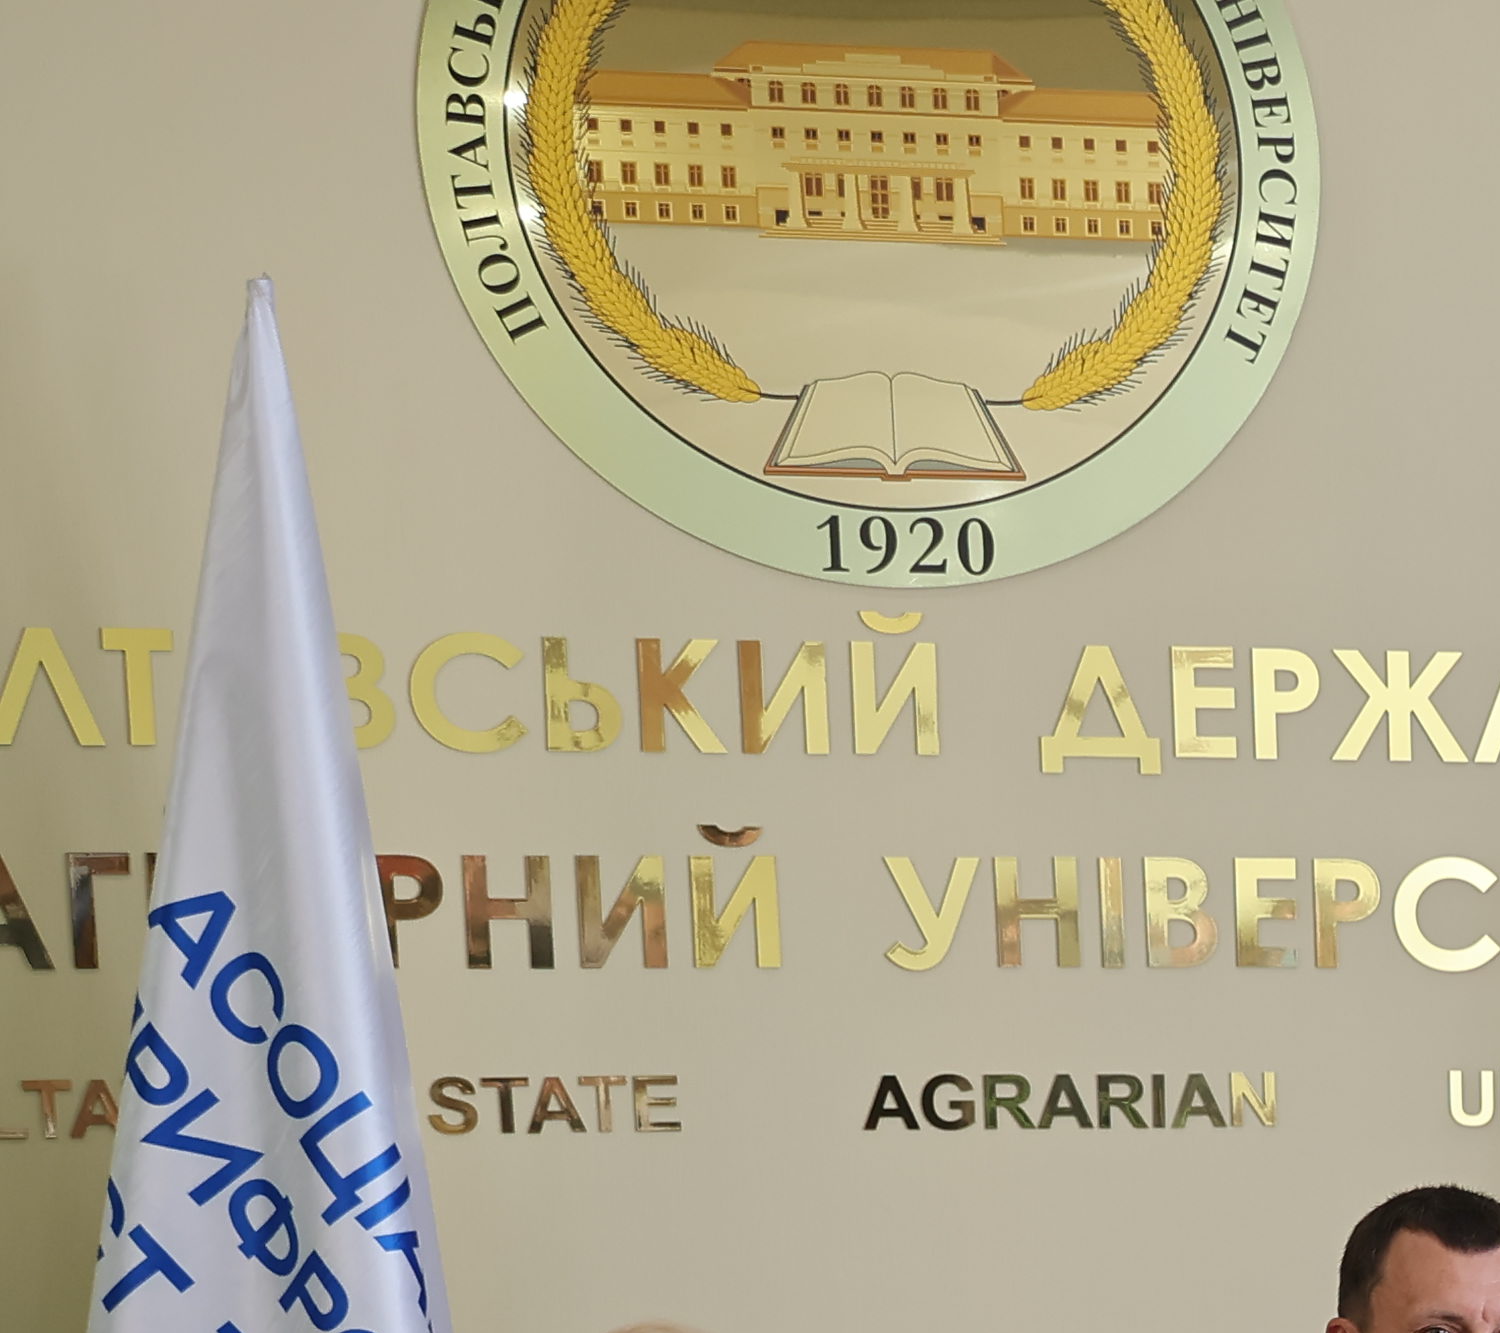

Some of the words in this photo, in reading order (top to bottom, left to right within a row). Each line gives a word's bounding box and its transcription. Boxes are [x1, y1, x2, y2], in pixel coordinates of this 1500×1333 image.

[446, 0, 548, 346] ПОЛТАВСЬ
[1216, 0, 1298, 365] НІВЕРСИТЕТ
[815, 515, 997, 577] 1920
[428, 1074, 683, 1135] STATE
[863, 1071, 1279, 1131] AGRARIAN
